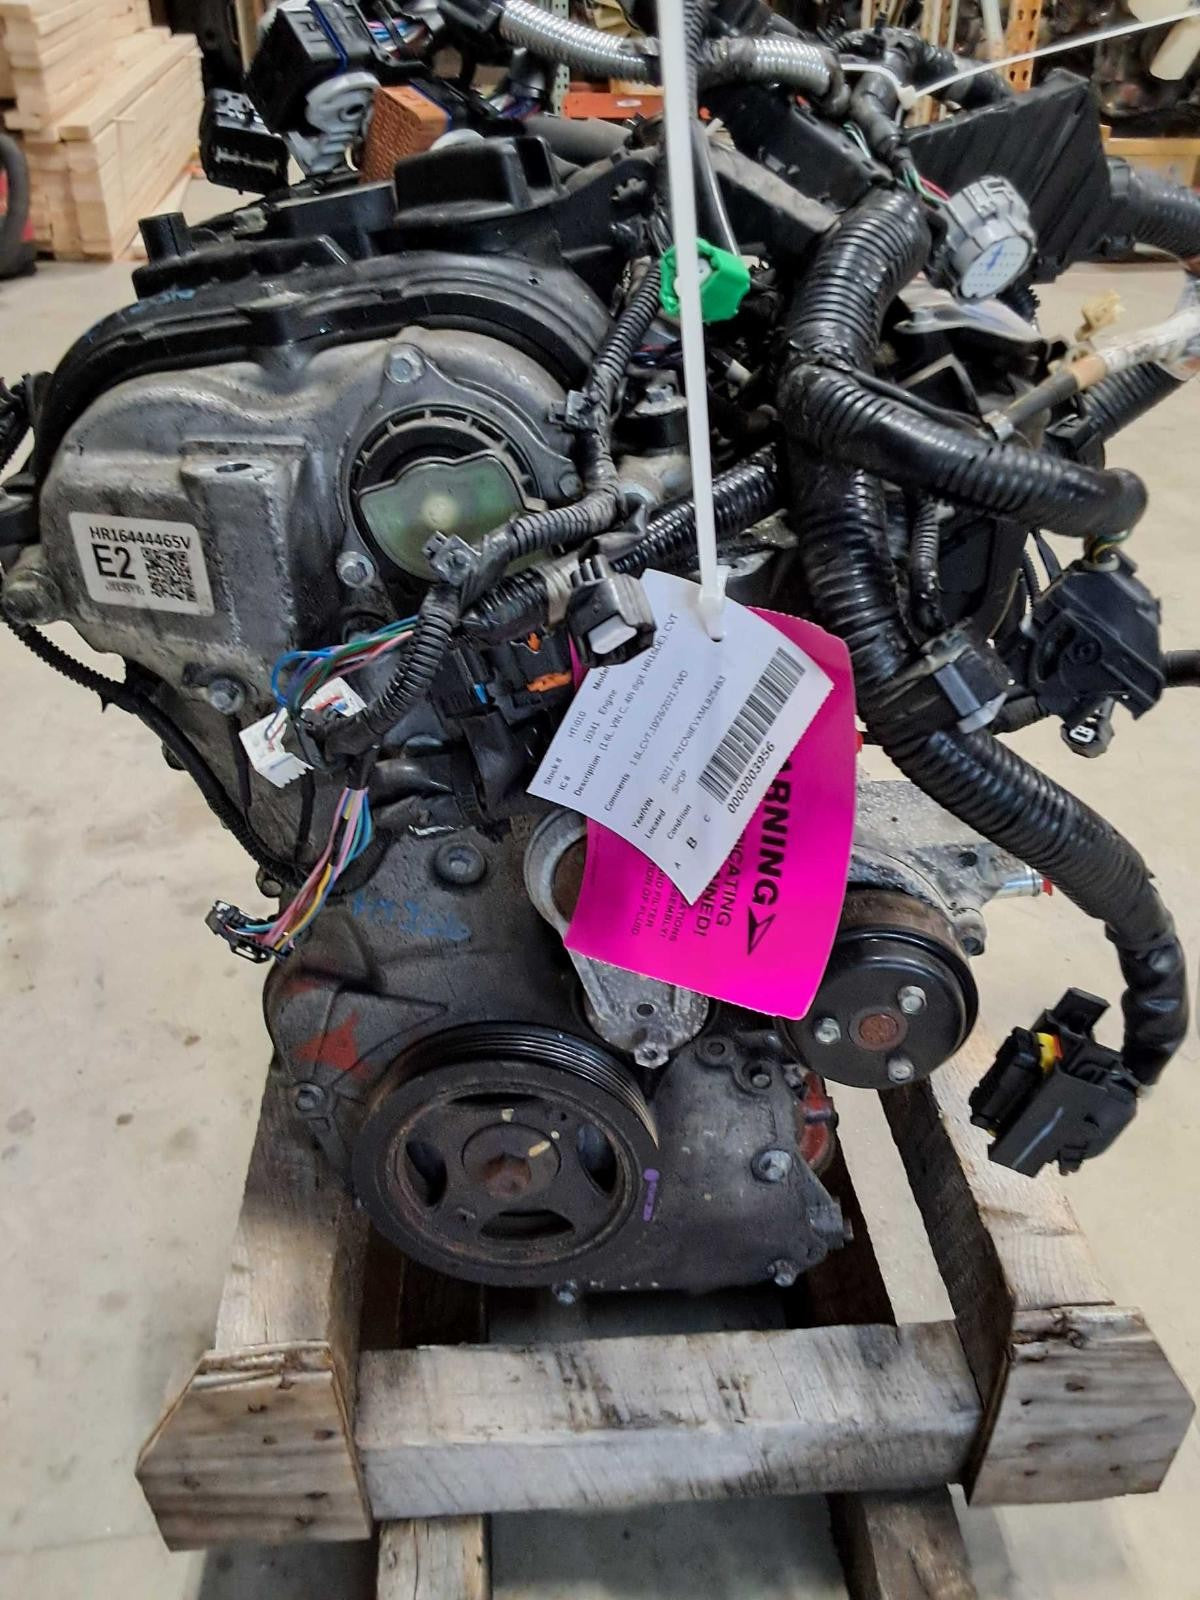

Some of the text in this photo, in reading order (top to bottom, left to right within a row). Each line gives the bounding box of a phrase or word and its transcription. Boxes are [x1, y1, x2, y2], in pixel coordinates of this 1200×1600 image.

[89, 526, 191, 549] HR16444465V
[91, 543, 136, 580] E2
[574, 754, 601, 797] Description
[610, 714, 622, 730] VIN
[624, 690, 635, 704] 4th
[663, 613, 678, 632] CVT
[558, 780, 567, 791] IC
[583, 720, 600, 744] 10341
[599, 688, 618, 716] Engine
[544, 764, 558, 786] Stock
[604, 772, 630, 812] Comments
[632, 797, 653, 829] Year/VIN
[659, 766, 672, 784] 2021
[644, 770, 689, 839] Located SHOP
[727, 741, 775, 815] 0000003956
[666, 804, 692, 840] Condition
[673, 814, 711, 869] A B C
[751, 760, 793, 906] RNING
[716, 836, 744, 927] ICATING
